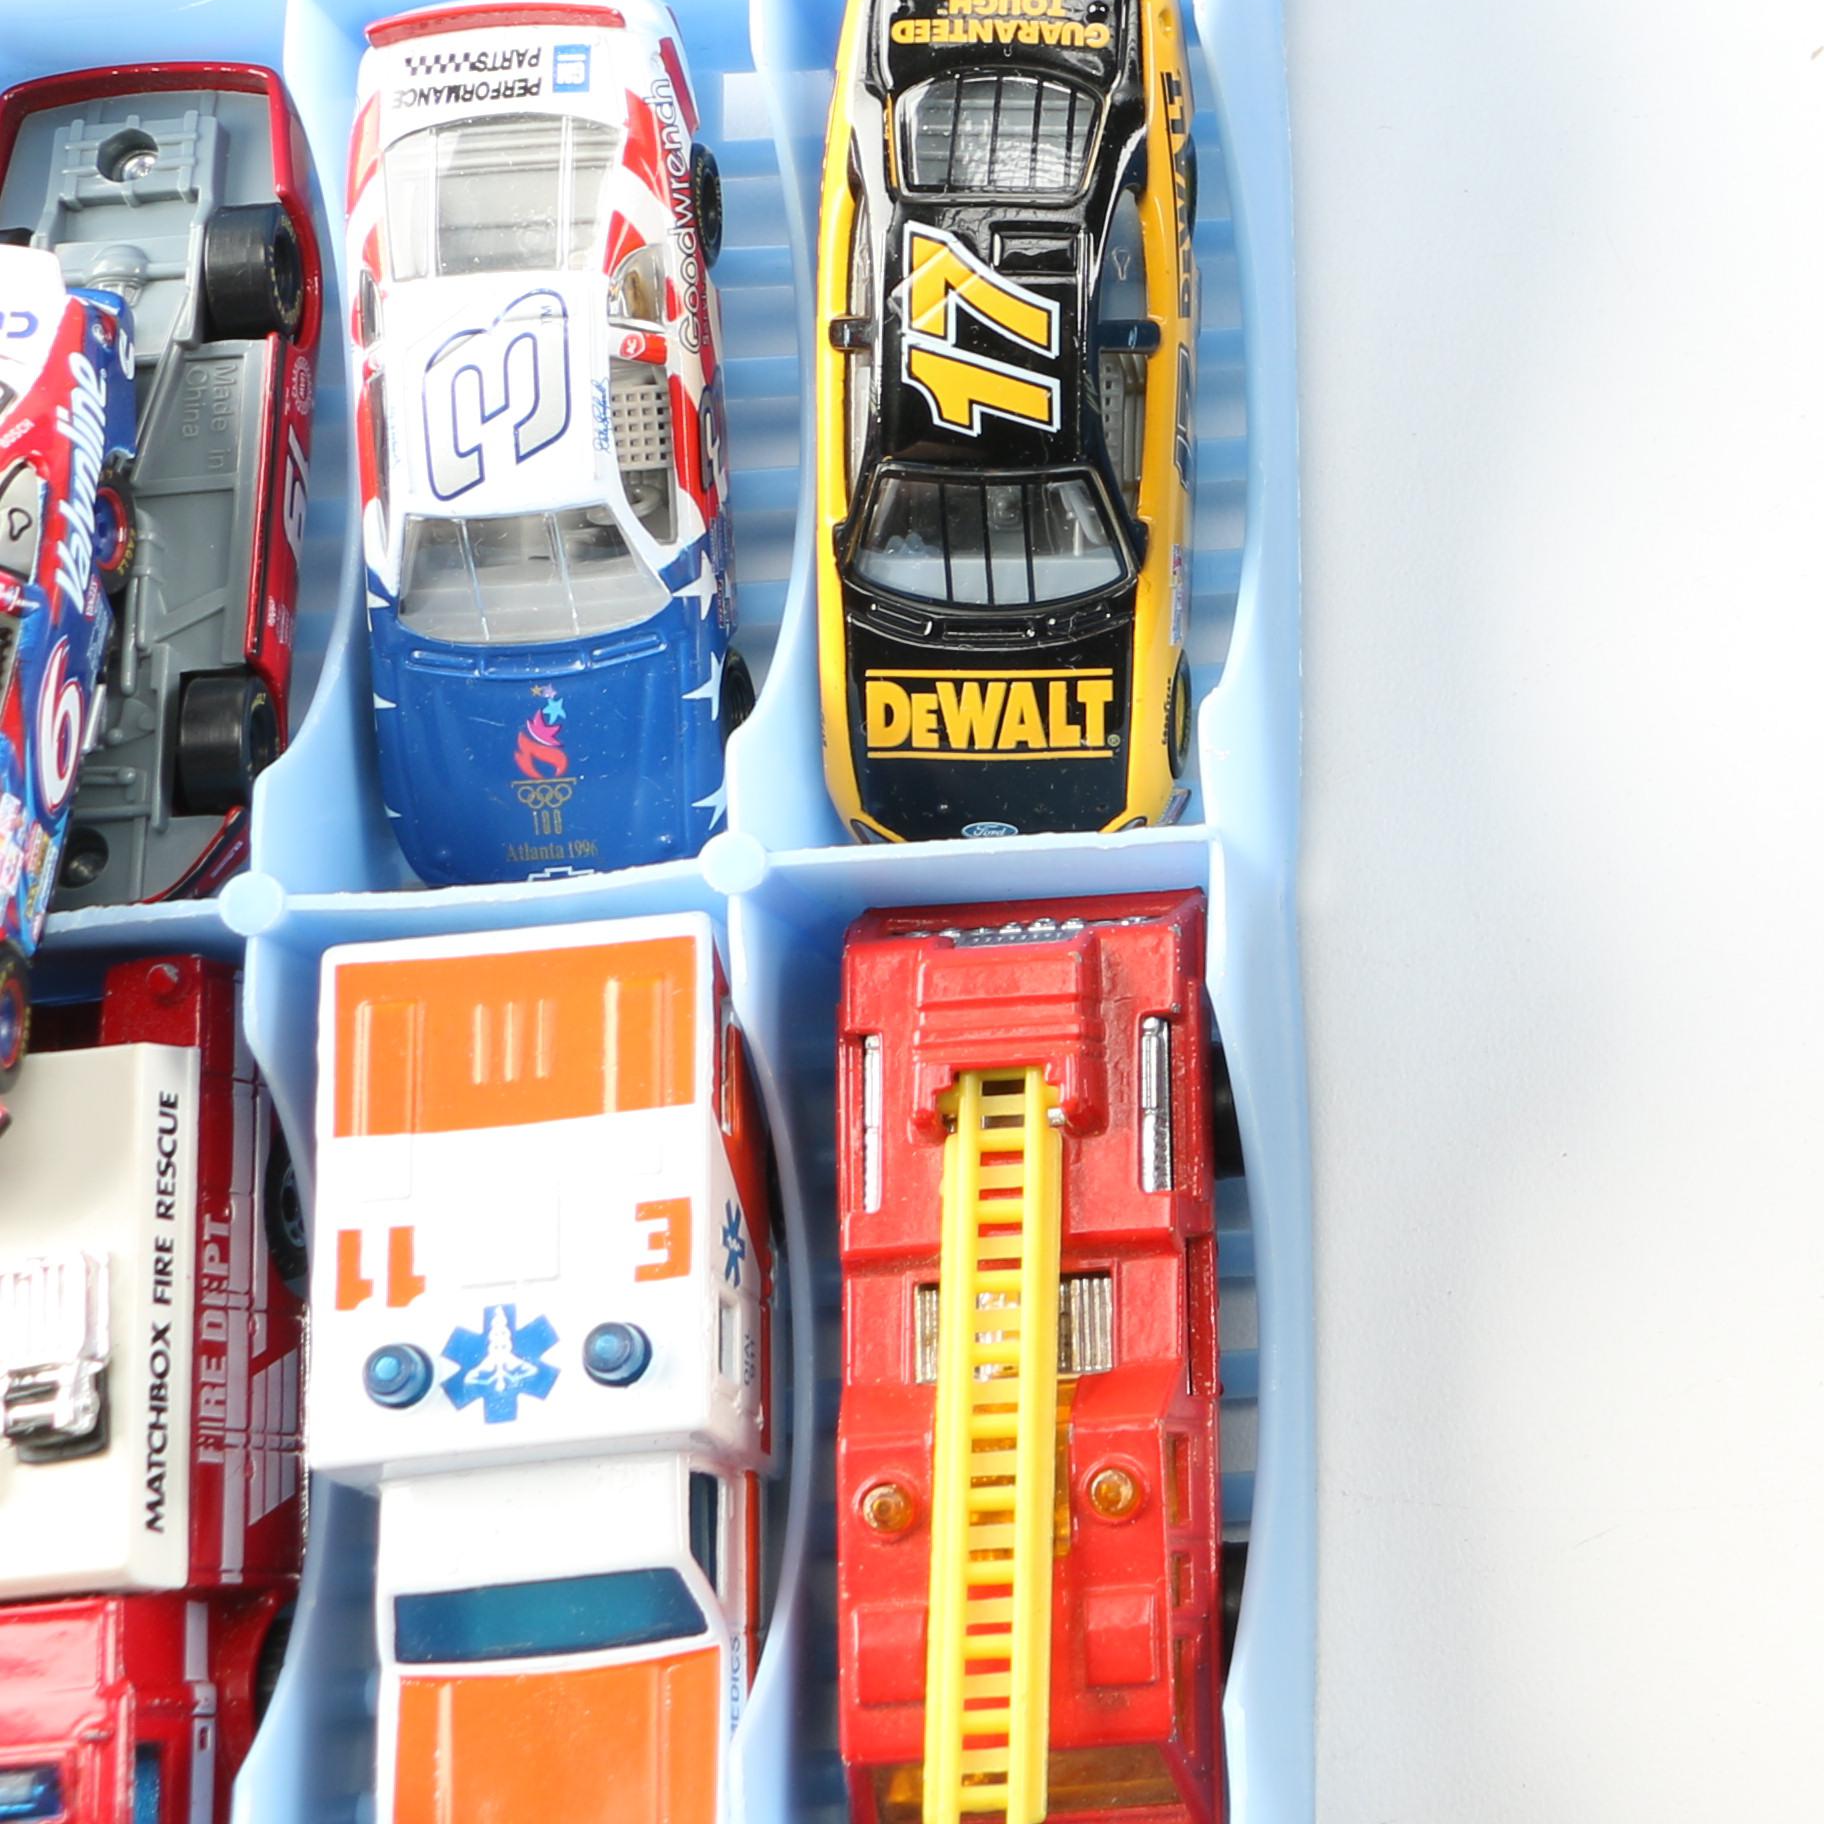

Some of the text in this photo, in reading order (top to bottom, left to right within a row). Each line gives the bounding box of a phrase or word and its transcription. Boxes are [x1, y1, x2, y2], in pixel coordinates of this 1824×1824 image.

[474, 46, 541, 73] PARTS
[891, 19, 1111, 49] GUARANTEED
[393, 77, 542, 109] PERFORMANCE
[643, 74, 703, 354] Goodwrench
[902, 220, 1061, 438] 17
[181, 367, 206, 439] China
[208, 363, 238, 470] Made in
[421, 287, 572, 502] 3
[37, 634, 85, 819] 6
[506, 839, 598, 863] Atlanta 1996
[334, 1196, 693, 1311] E 11
[144, 1090, 180, 1534] MATCHBOX FIRE RESCUE
[198, 1211, 231, 1466] FIRE DEPT
